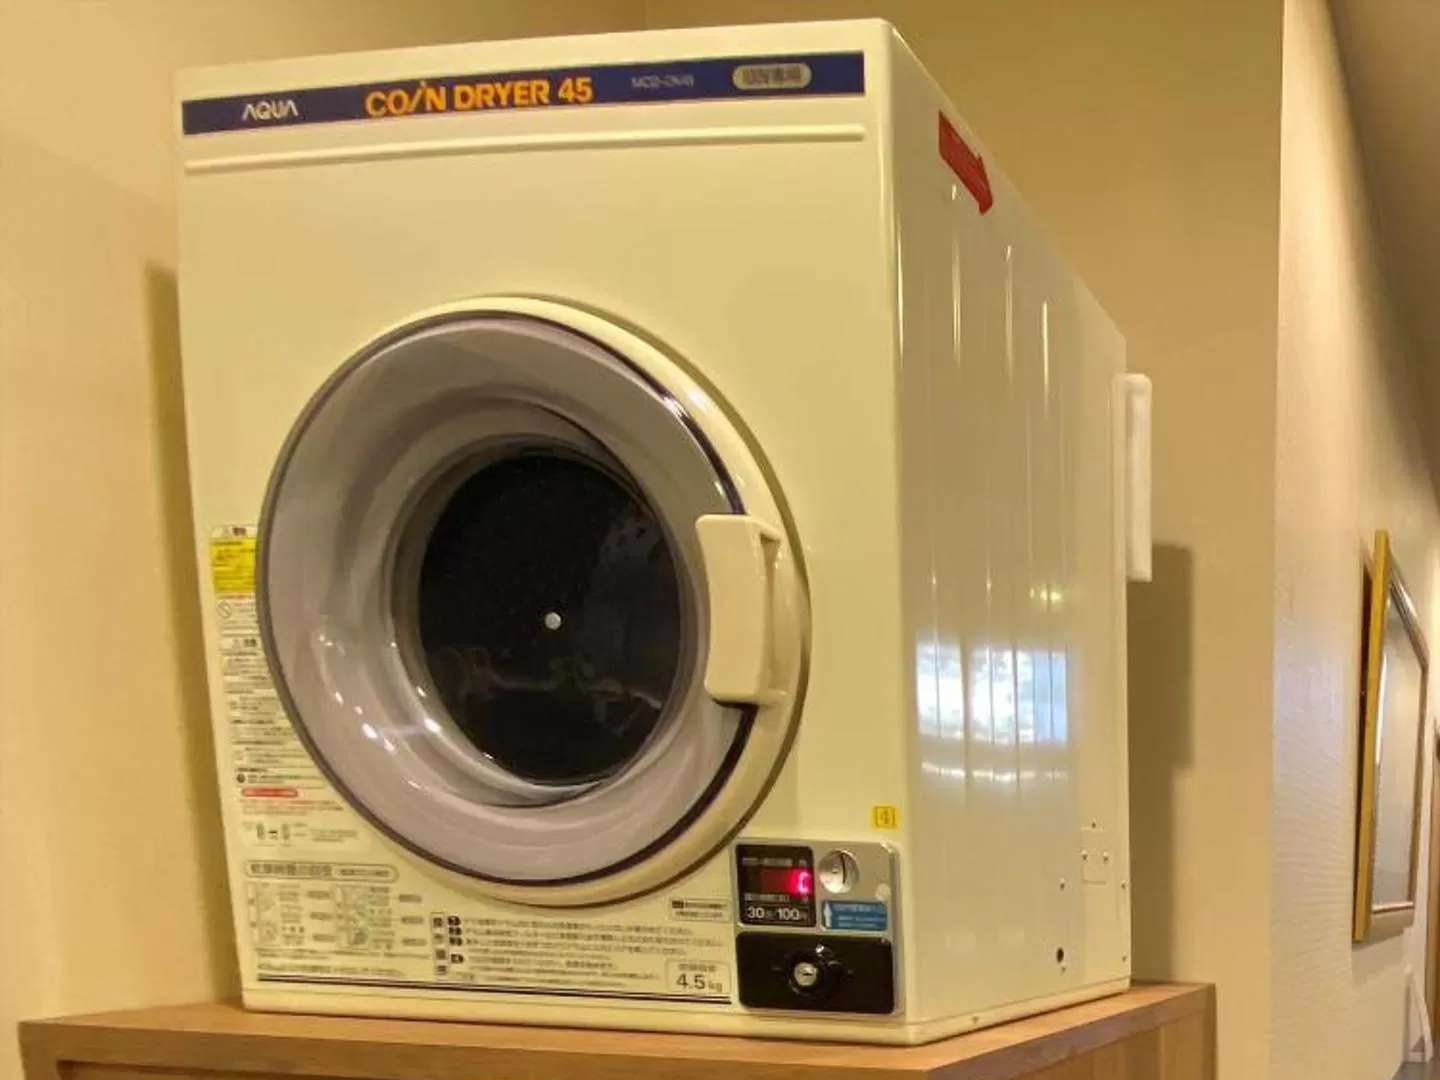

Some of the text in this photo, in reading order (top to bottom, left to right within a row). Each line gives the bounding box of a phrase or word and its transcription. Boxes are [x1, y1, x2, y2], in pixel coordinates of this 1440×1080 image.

[242, 99, 299, 121] AQUA
[452, 78, 551, 111] DRYER
[558, 75, 594, 103] 45
